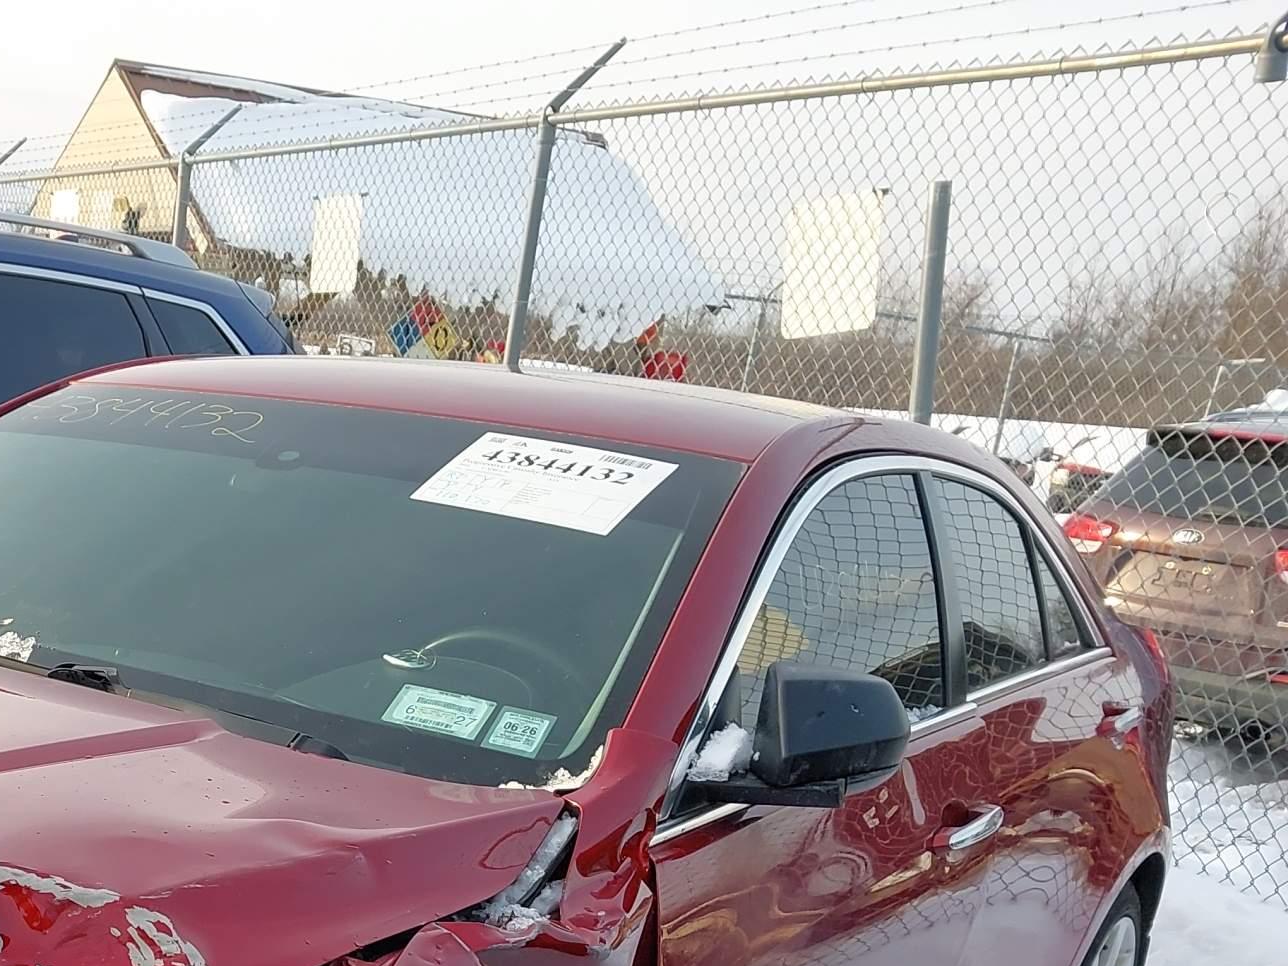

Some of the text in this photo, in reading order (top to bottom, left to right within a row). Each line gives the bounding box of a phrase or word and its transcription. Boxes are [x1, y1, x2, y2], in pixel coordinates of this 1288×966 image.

[481, 449, 635, 485] 43844132
[405, 704, 416, 715] 6
[453, 715, 478, 728] 27
[503, 721, 538, 736] 06 26
